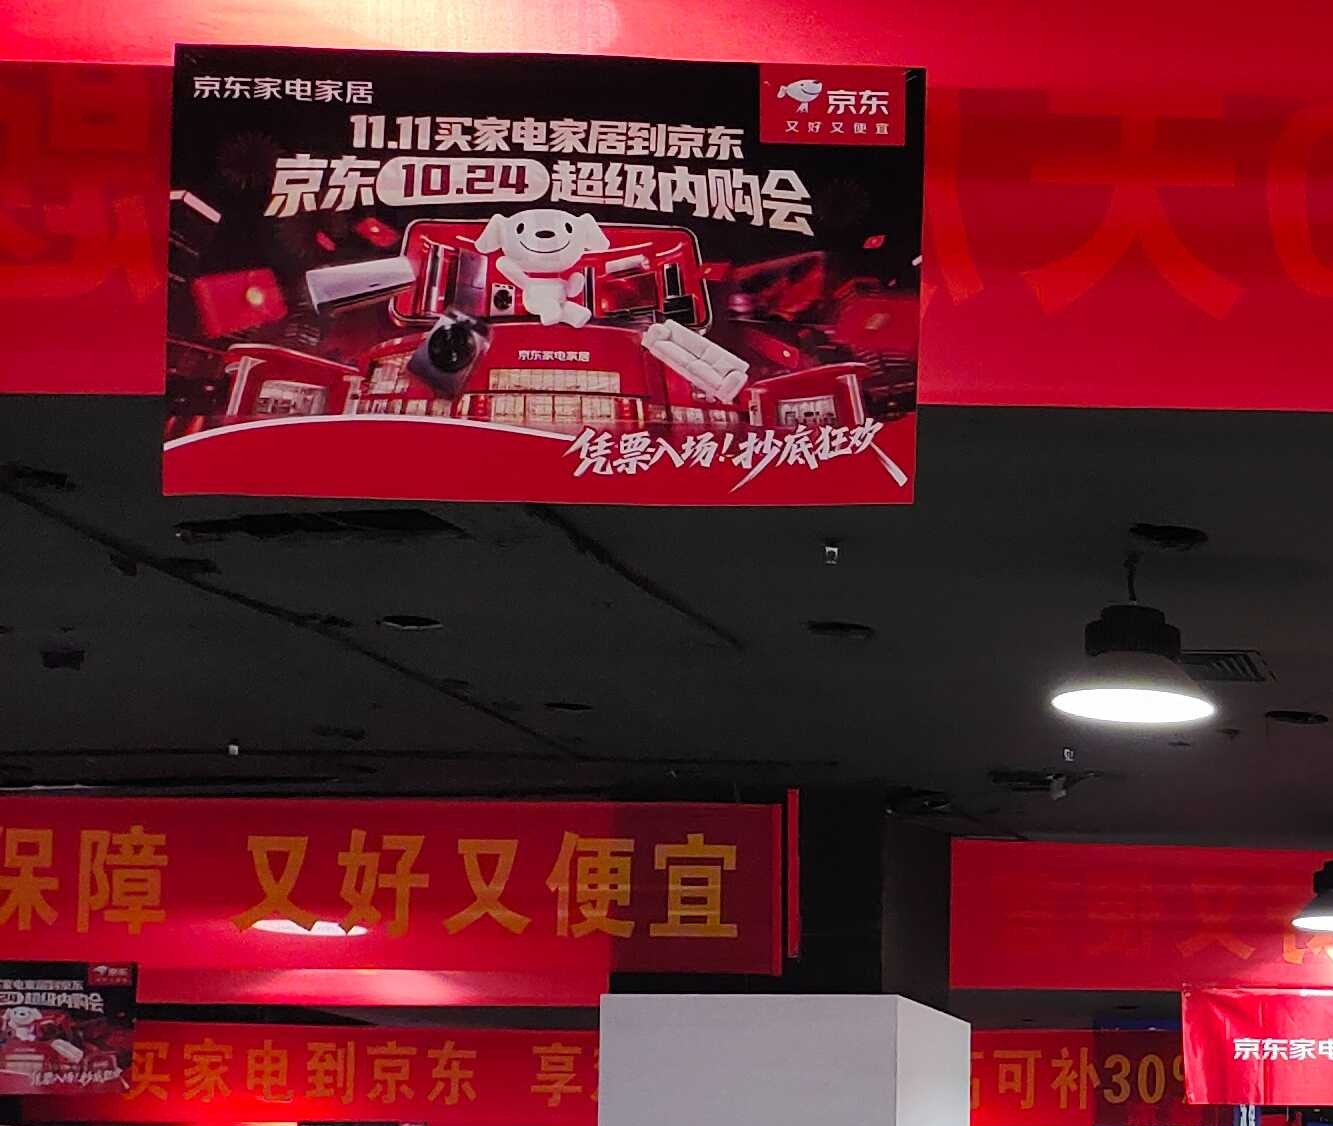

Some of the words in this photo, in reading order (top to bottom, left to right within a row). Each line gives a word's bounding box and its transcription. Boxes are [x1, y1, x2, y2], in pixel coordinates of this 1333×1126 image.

[193, 75, 374, 104] 京东家电家居
[827, 88, 889, 116] 京东
[349, 115, 743, 162] 11.11买家电家居到京东
[785, 119, 890, 136] 又好又便宜
[563, 417, 911, 490] 凭票入场!抄底狂欢
[232, 828, 740, 939] 又好又便宜
[119, 1038, 478, 1107] 买家电到京东
[530, 1041, 600, 1107] 享
